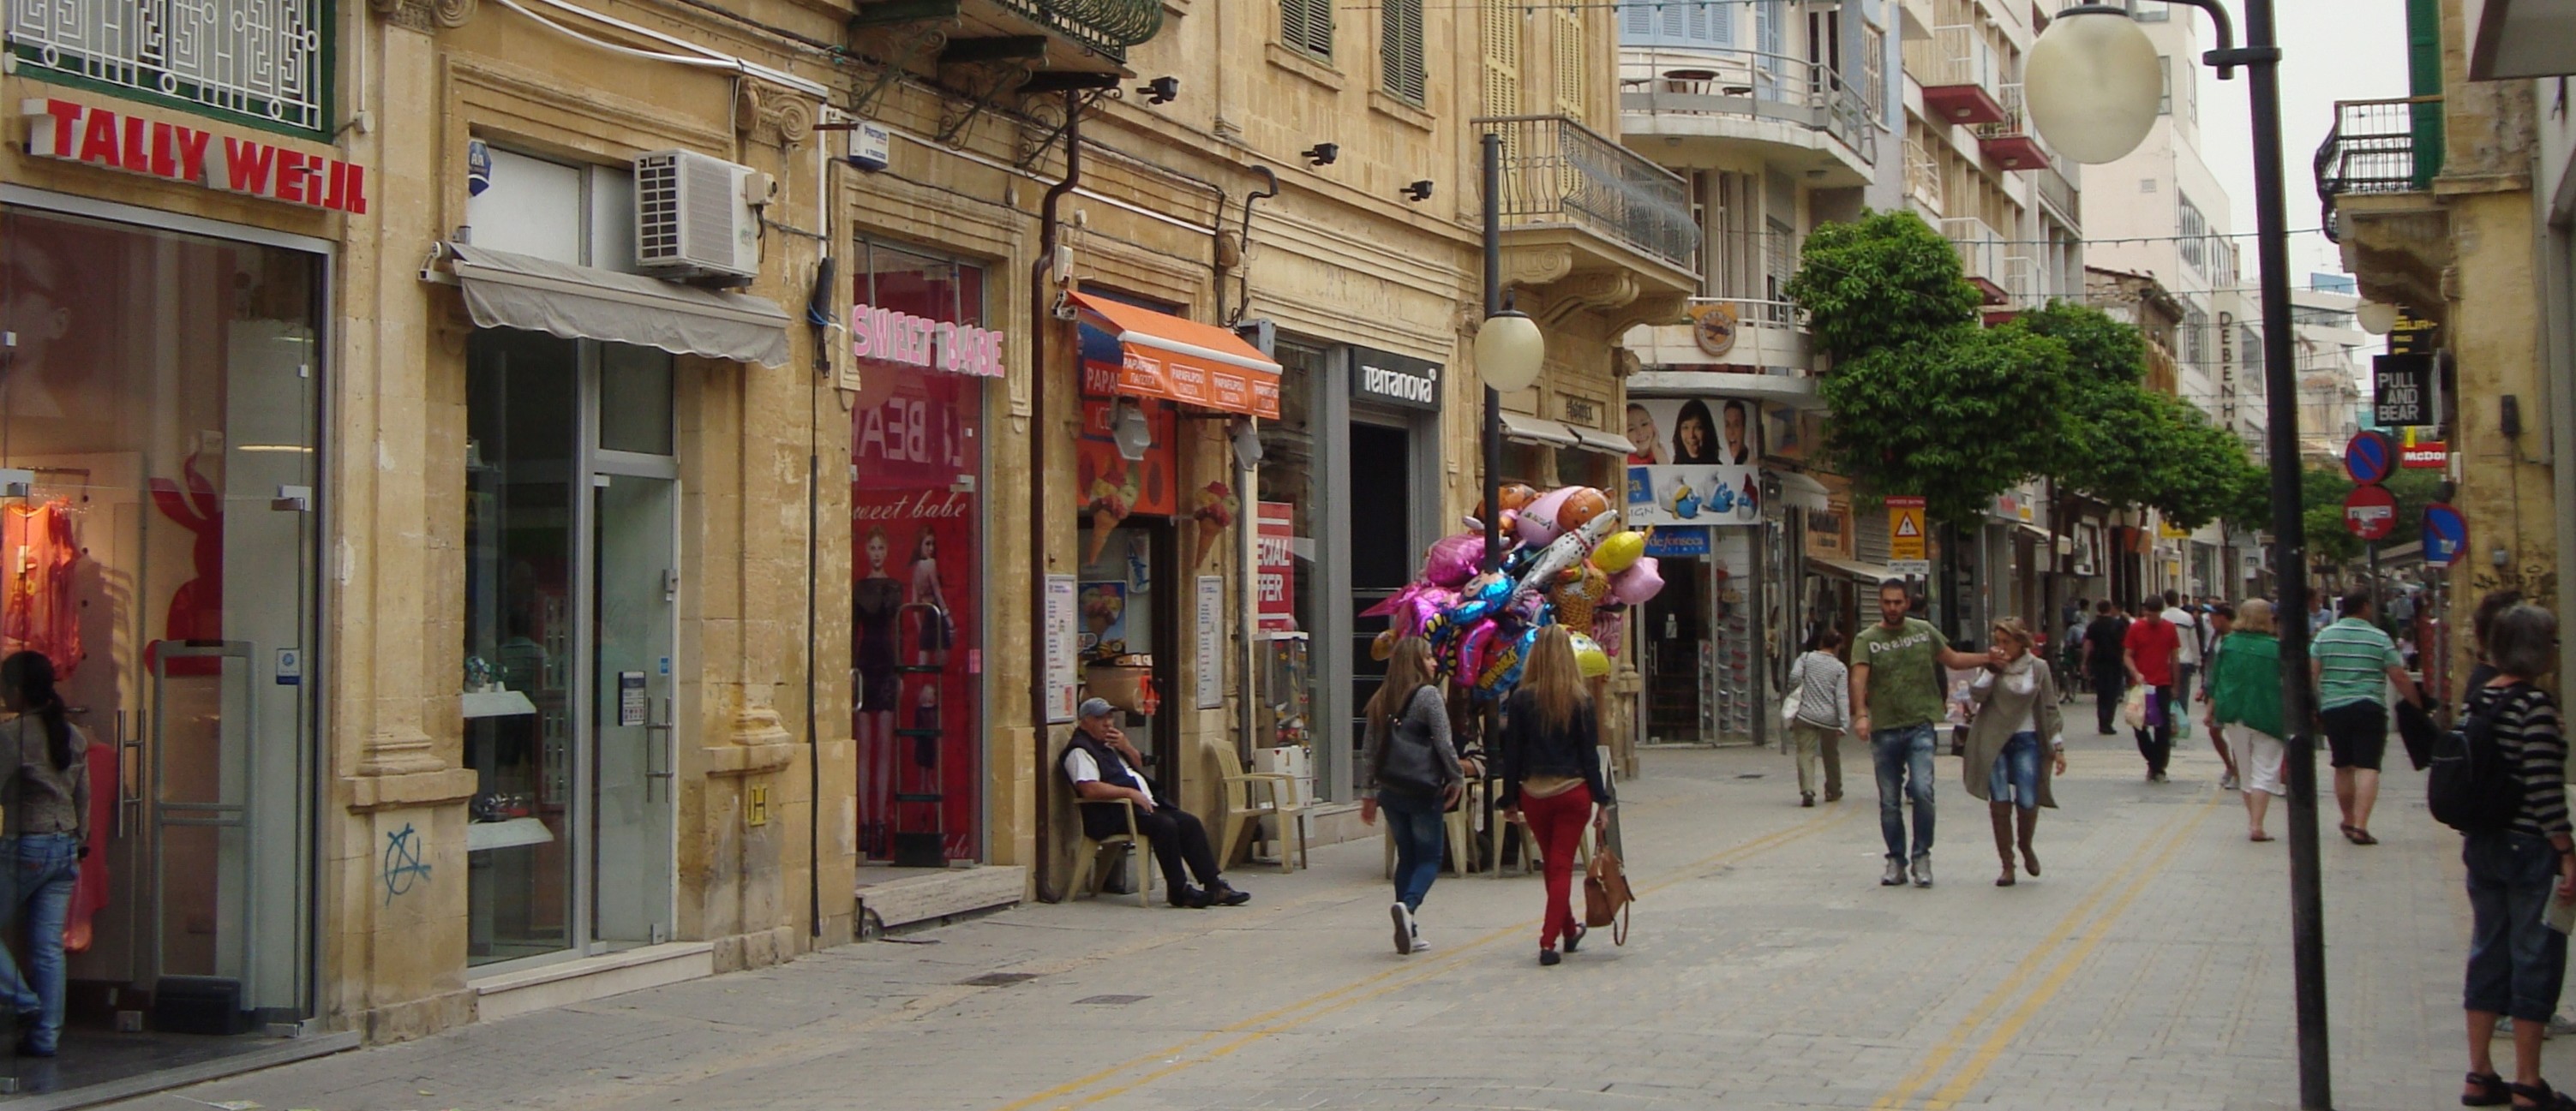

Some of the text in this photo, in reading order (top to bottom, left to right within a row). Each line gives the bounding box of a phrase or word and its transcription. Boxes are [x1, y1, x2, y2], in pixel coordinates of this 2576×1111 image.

[47, 98, 210, 182] TALLY
[853, 304, 1004, 378] SWEET BABE
[2378, 372, 2417, 388] PULL
[2387, 388, 2417, 404] AND
[2379, 405, 2418, 421] BEAR
[910, 489, 967, 518] babe
